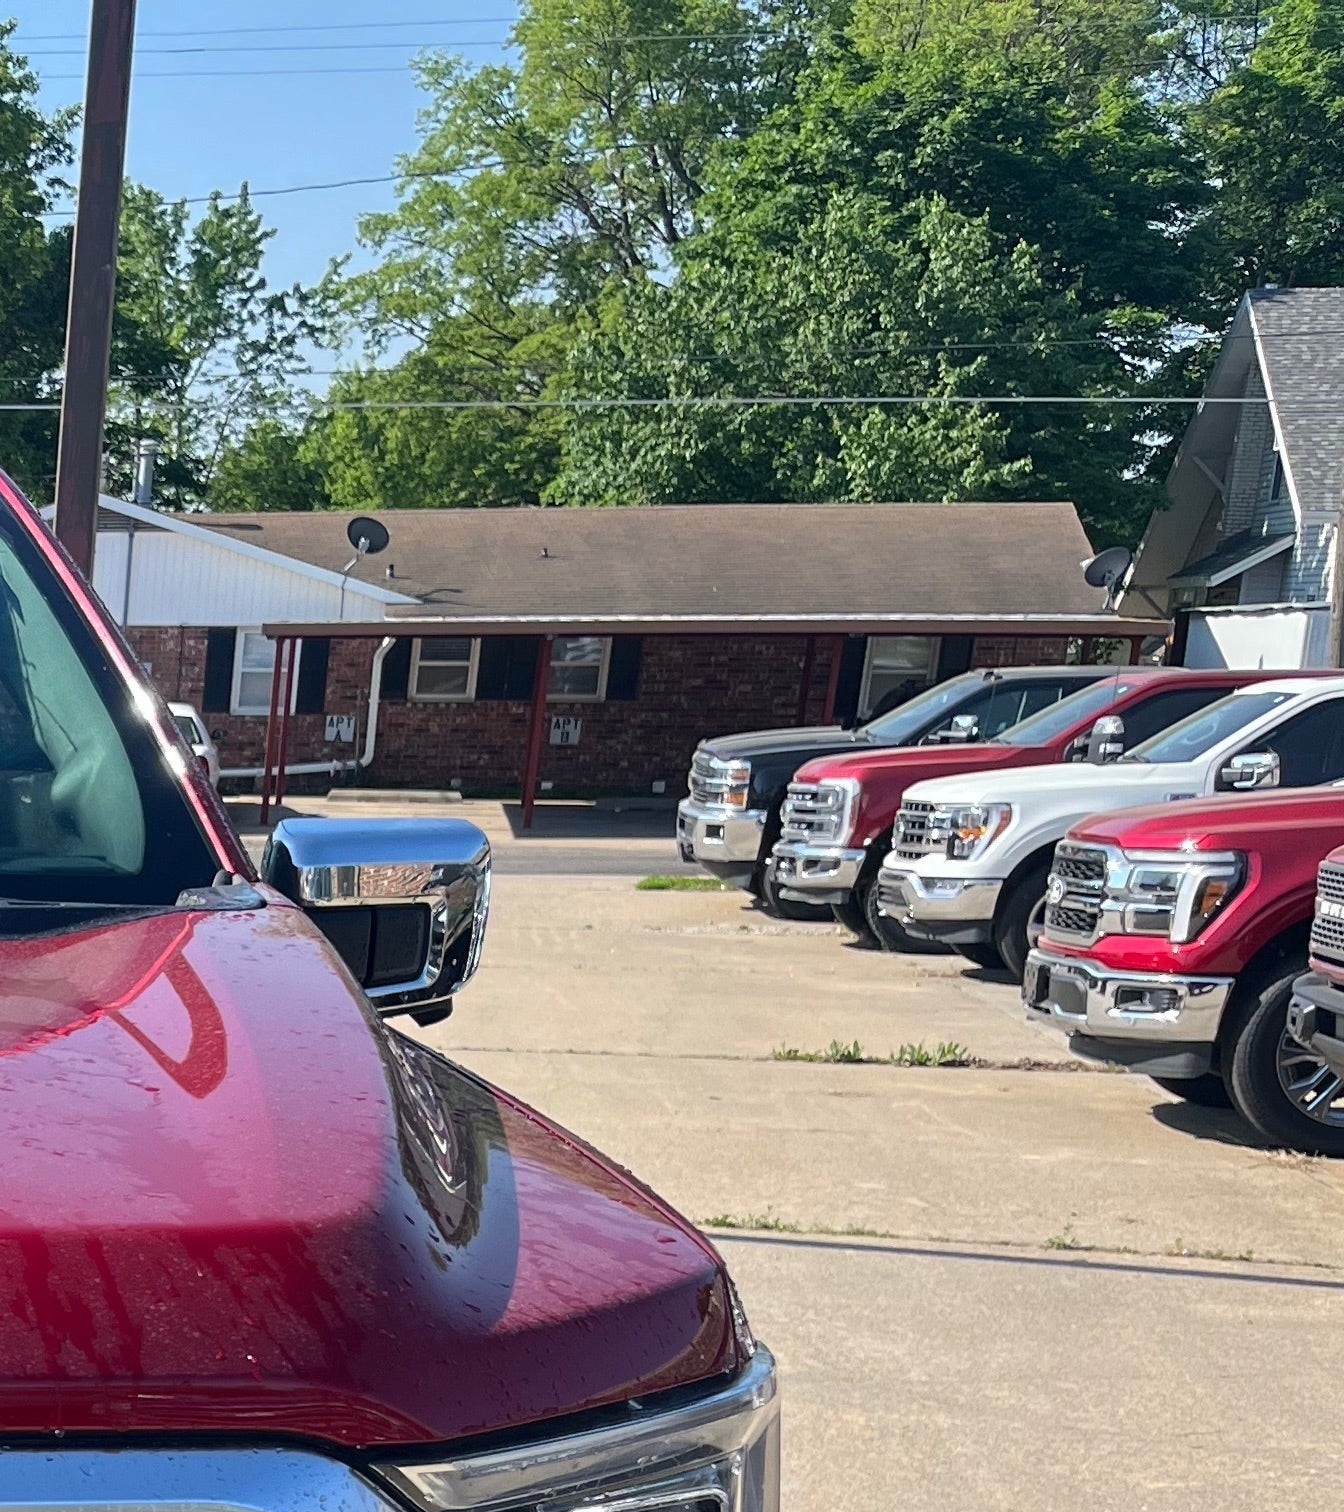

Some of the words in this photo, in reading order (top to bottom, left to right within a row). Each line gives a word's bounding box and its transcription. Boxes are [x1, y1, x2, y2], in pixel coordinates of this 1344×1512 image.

[328, 716, 354, 728] APT
[553, 718, 581, 730] APT
[334, 729, 343, 742] A
